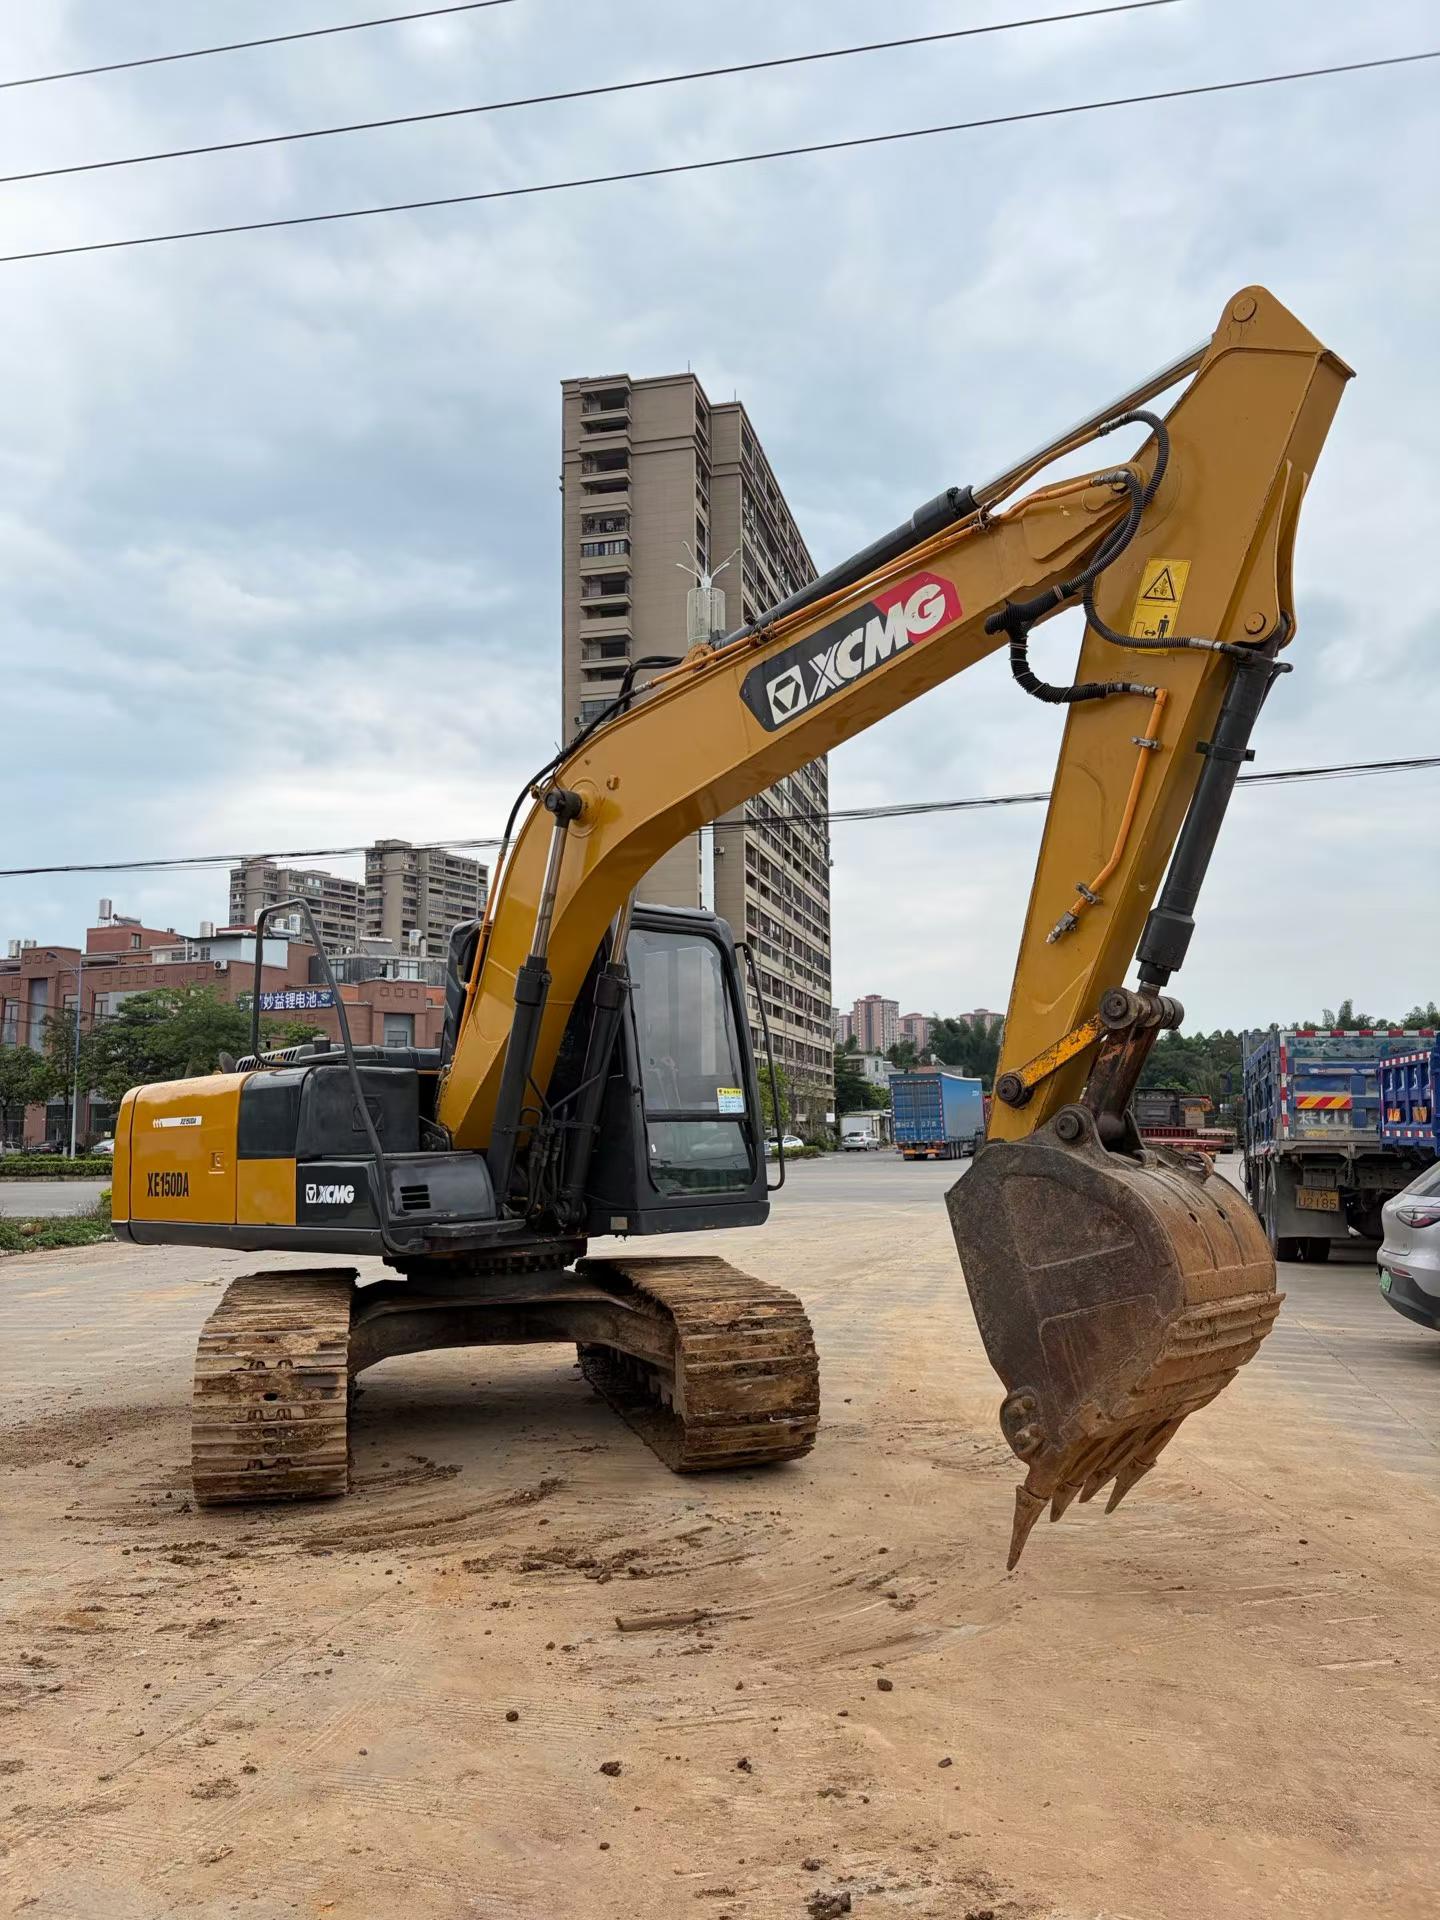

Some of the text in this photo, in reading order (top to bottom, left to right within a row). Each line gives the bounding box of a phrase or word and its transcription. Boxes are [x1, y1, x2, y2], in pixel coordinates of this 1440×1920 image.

[808, 583, 946, 704] XCMG
[147, 1172, 190, 1197] XE150DA
[317, 1185, 355, 1204] XCMG
